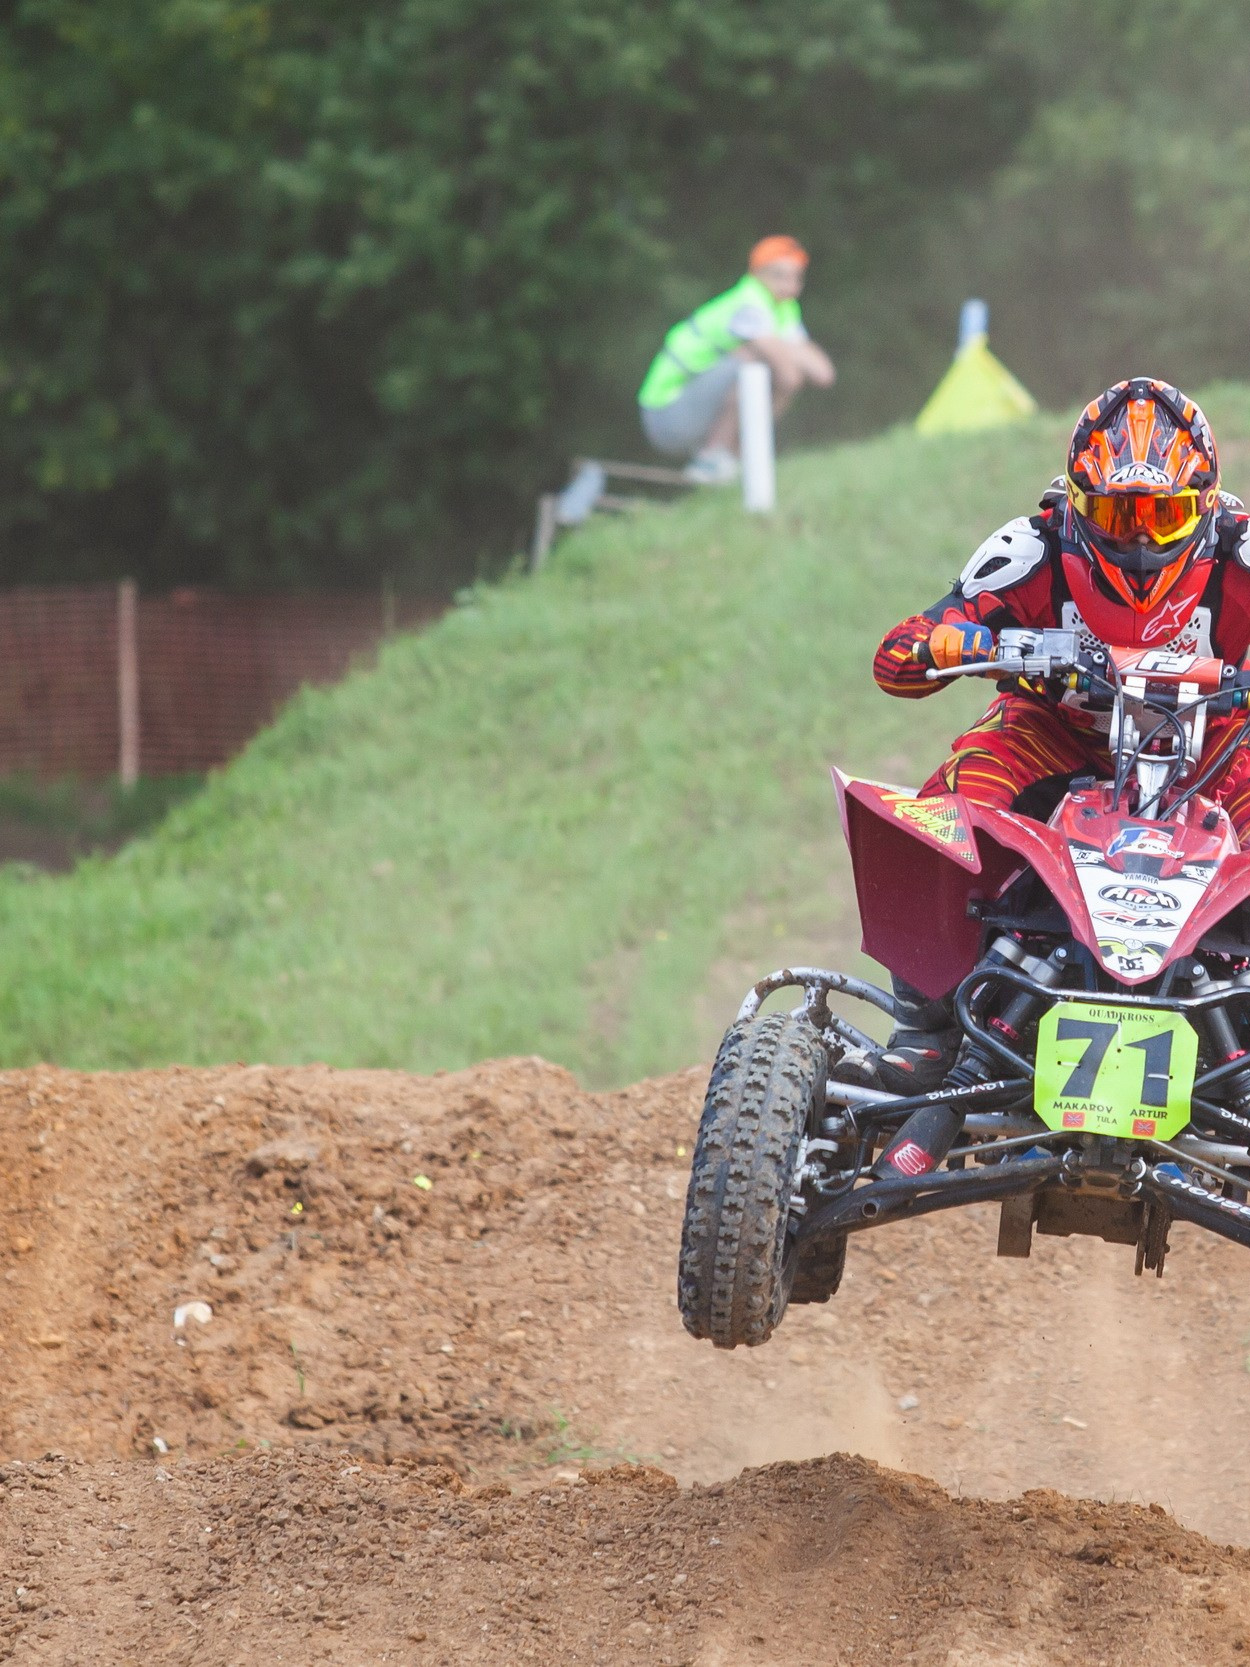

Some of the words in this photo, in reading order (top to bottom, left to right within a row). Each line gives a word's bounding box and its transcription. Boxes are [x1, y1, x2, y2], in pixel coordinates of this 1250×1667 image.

[1110, 464, 1169, 483] Airoh
[1124, 873, 1160, 885] YAMAHA
[1102, 885, 1176, 910] Airoh
[1089, 1008, 1156, 1023] QUADKROSS
[1055, 1017, 1175, 1109] 71
[1053, 1101, 1114, 1114] MAKAROV
[1129, 1108, 1169, 1120] ARTUR
[1096, 1115, 1119, 1125] TULA
